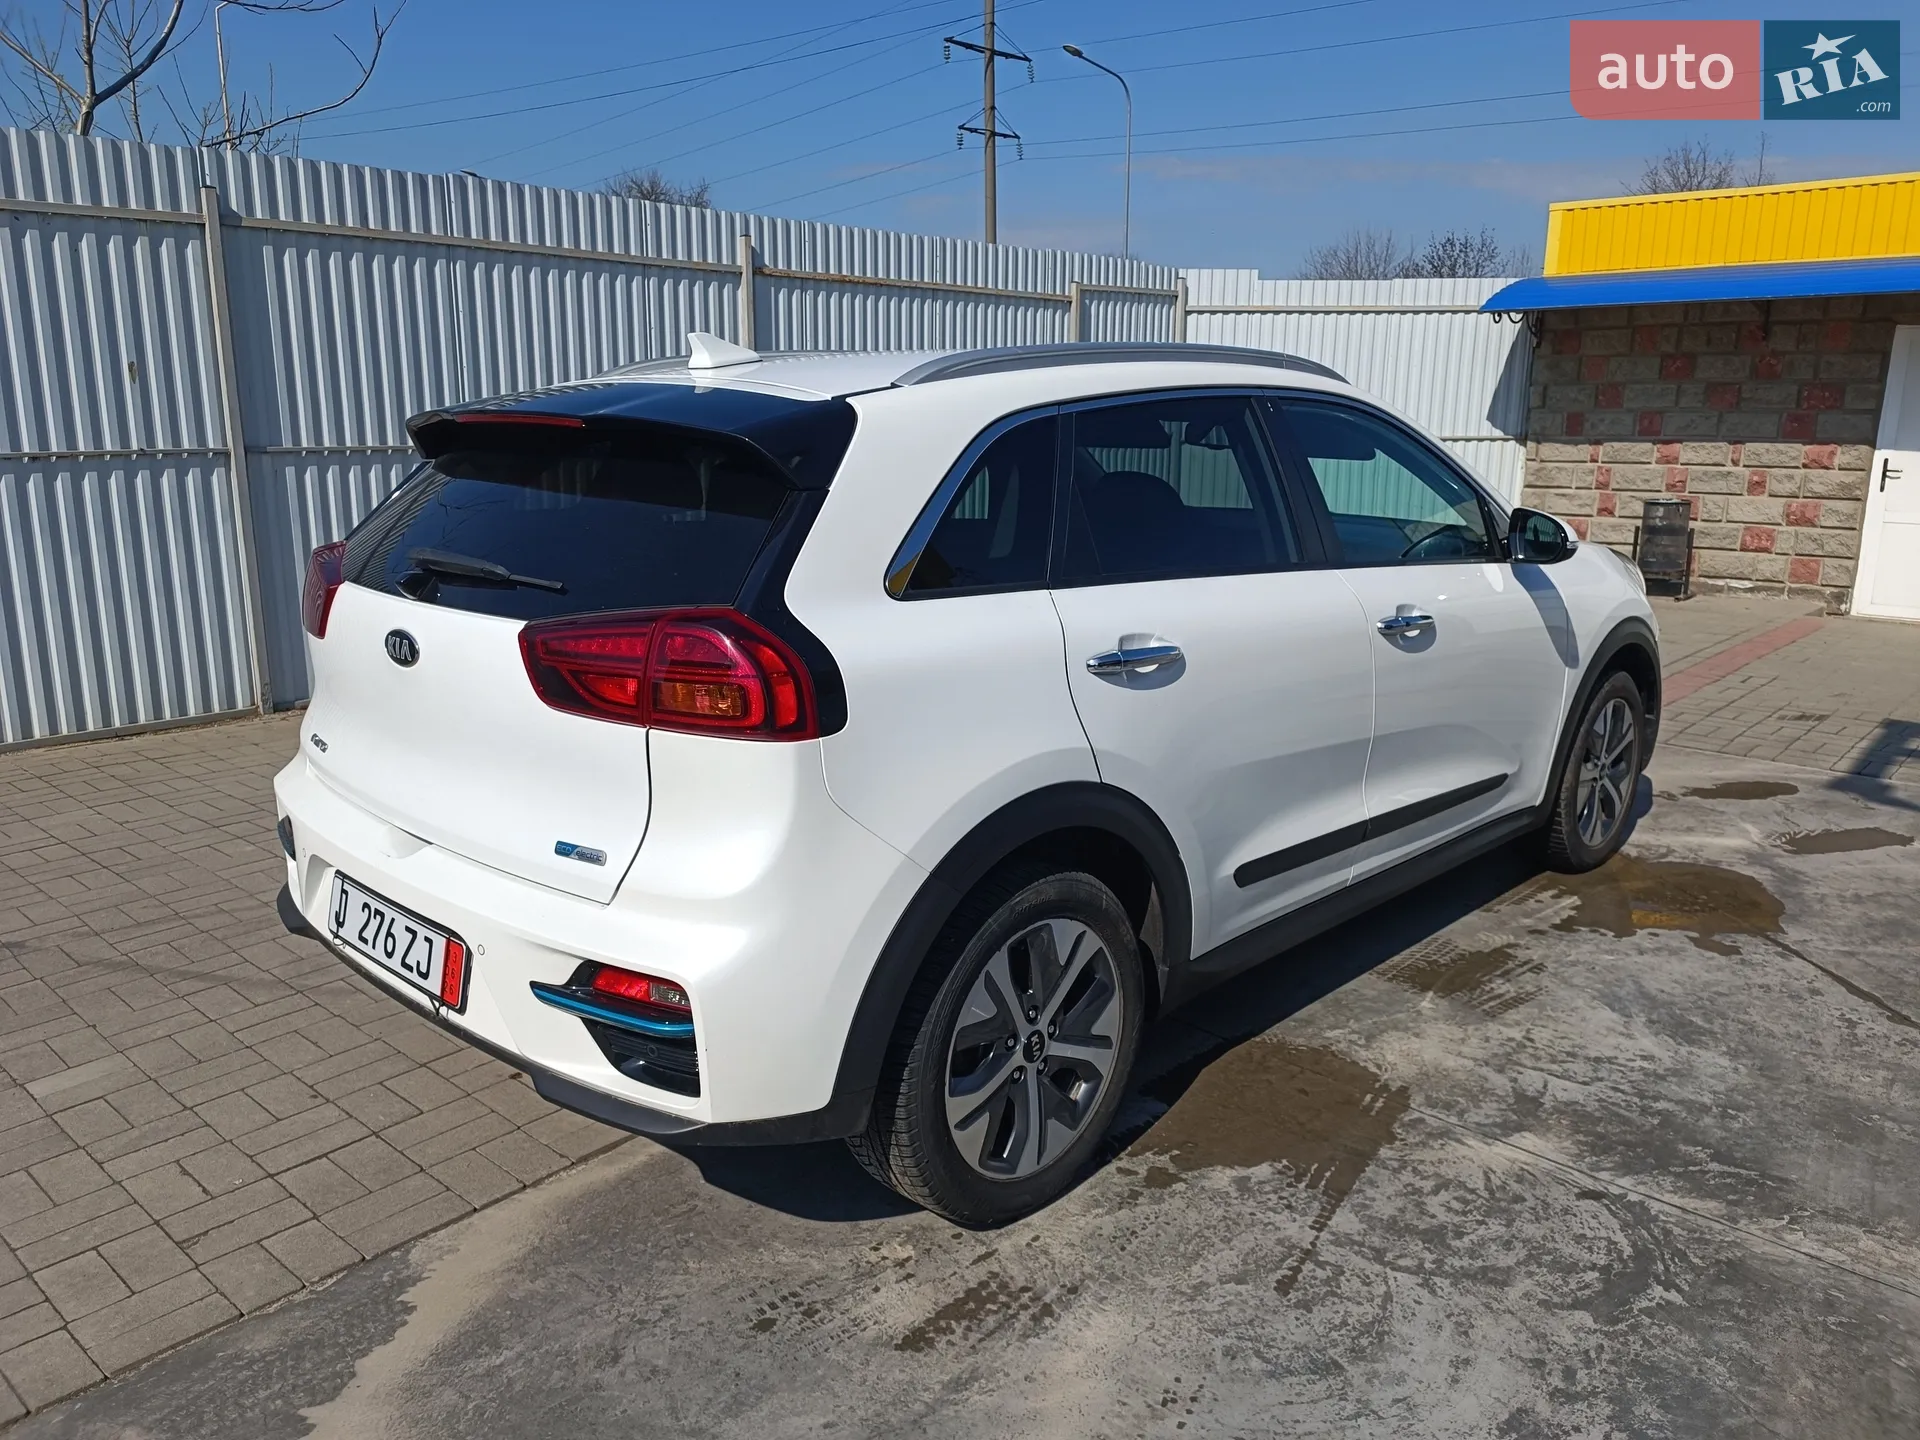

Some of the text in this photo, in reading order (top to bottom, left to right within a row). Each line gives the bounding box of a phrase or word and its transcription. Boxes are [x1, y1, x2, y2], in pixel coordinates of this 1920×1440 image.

[387, 635, 412, 661] KIA
[575, 849, 602, 862] electric
[358, 901, 396, 959] 276
[400, 925, 434, 981] ZJ
[1030, 1034, 1041, 1061] KIA
